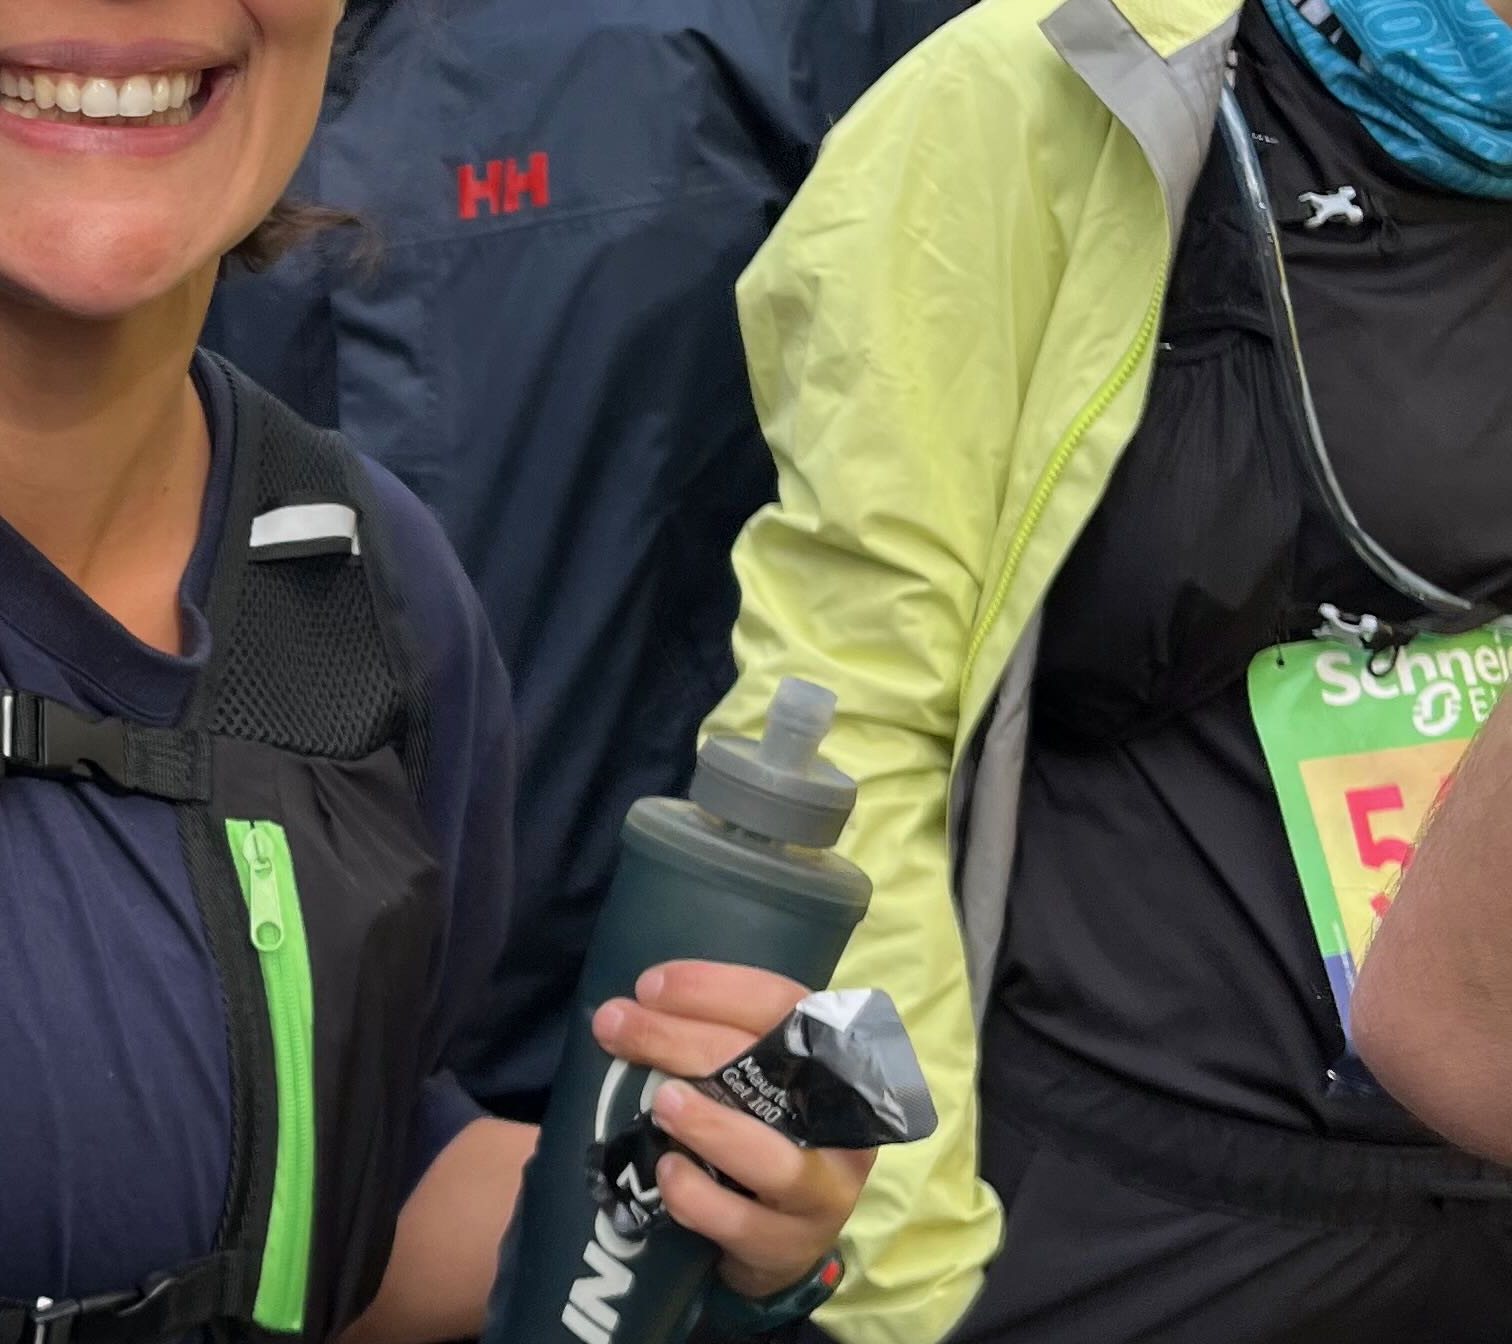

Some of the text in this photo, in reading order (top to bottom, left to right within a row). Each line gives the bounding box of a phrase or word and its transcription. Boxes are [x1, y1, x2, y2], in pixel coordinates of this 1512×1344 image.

[457, 151, 550, 220] HH
[1316, 632, 1512, 706] Schnei
[722, 1067, 753, 1099] Gel
[747, 1096, 782, 1124] 100
